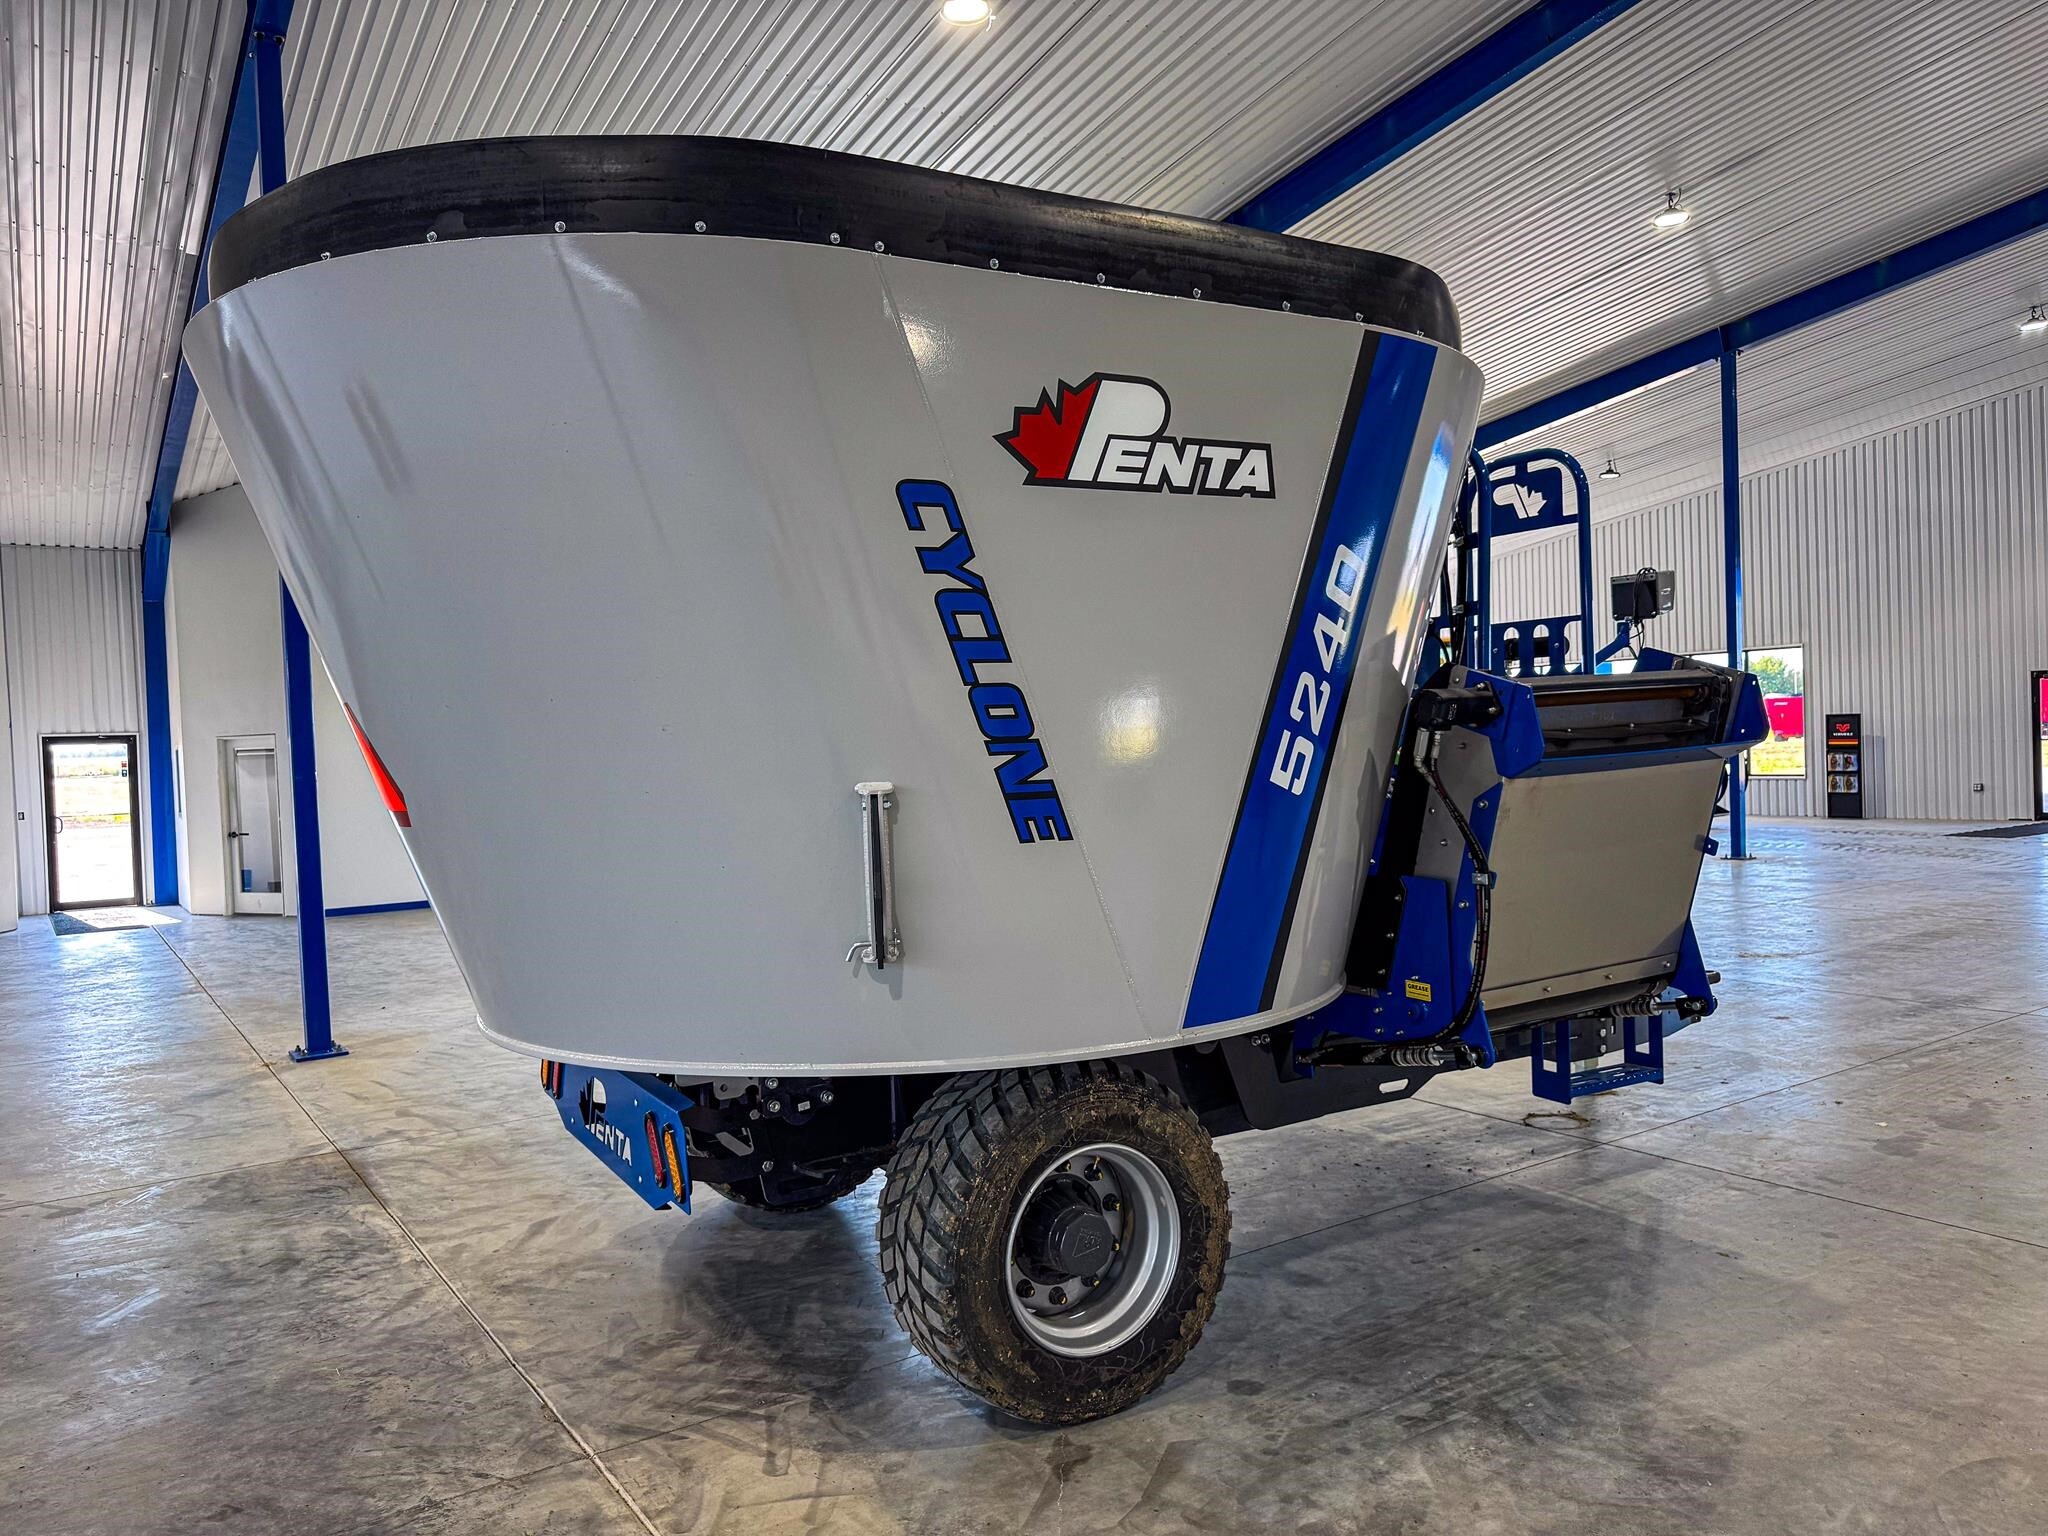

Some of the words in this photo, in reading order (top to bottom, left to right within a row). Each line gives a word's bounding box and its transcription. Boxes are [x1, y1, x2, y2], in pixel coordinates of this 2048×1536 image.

[1066, 375, 1273, 495] PENTA
[895, 478, 1074, 843] CYCLONE
[1269, 543, 1365, 796] 5240
[1408, 984, 1429, 992] GREASE
